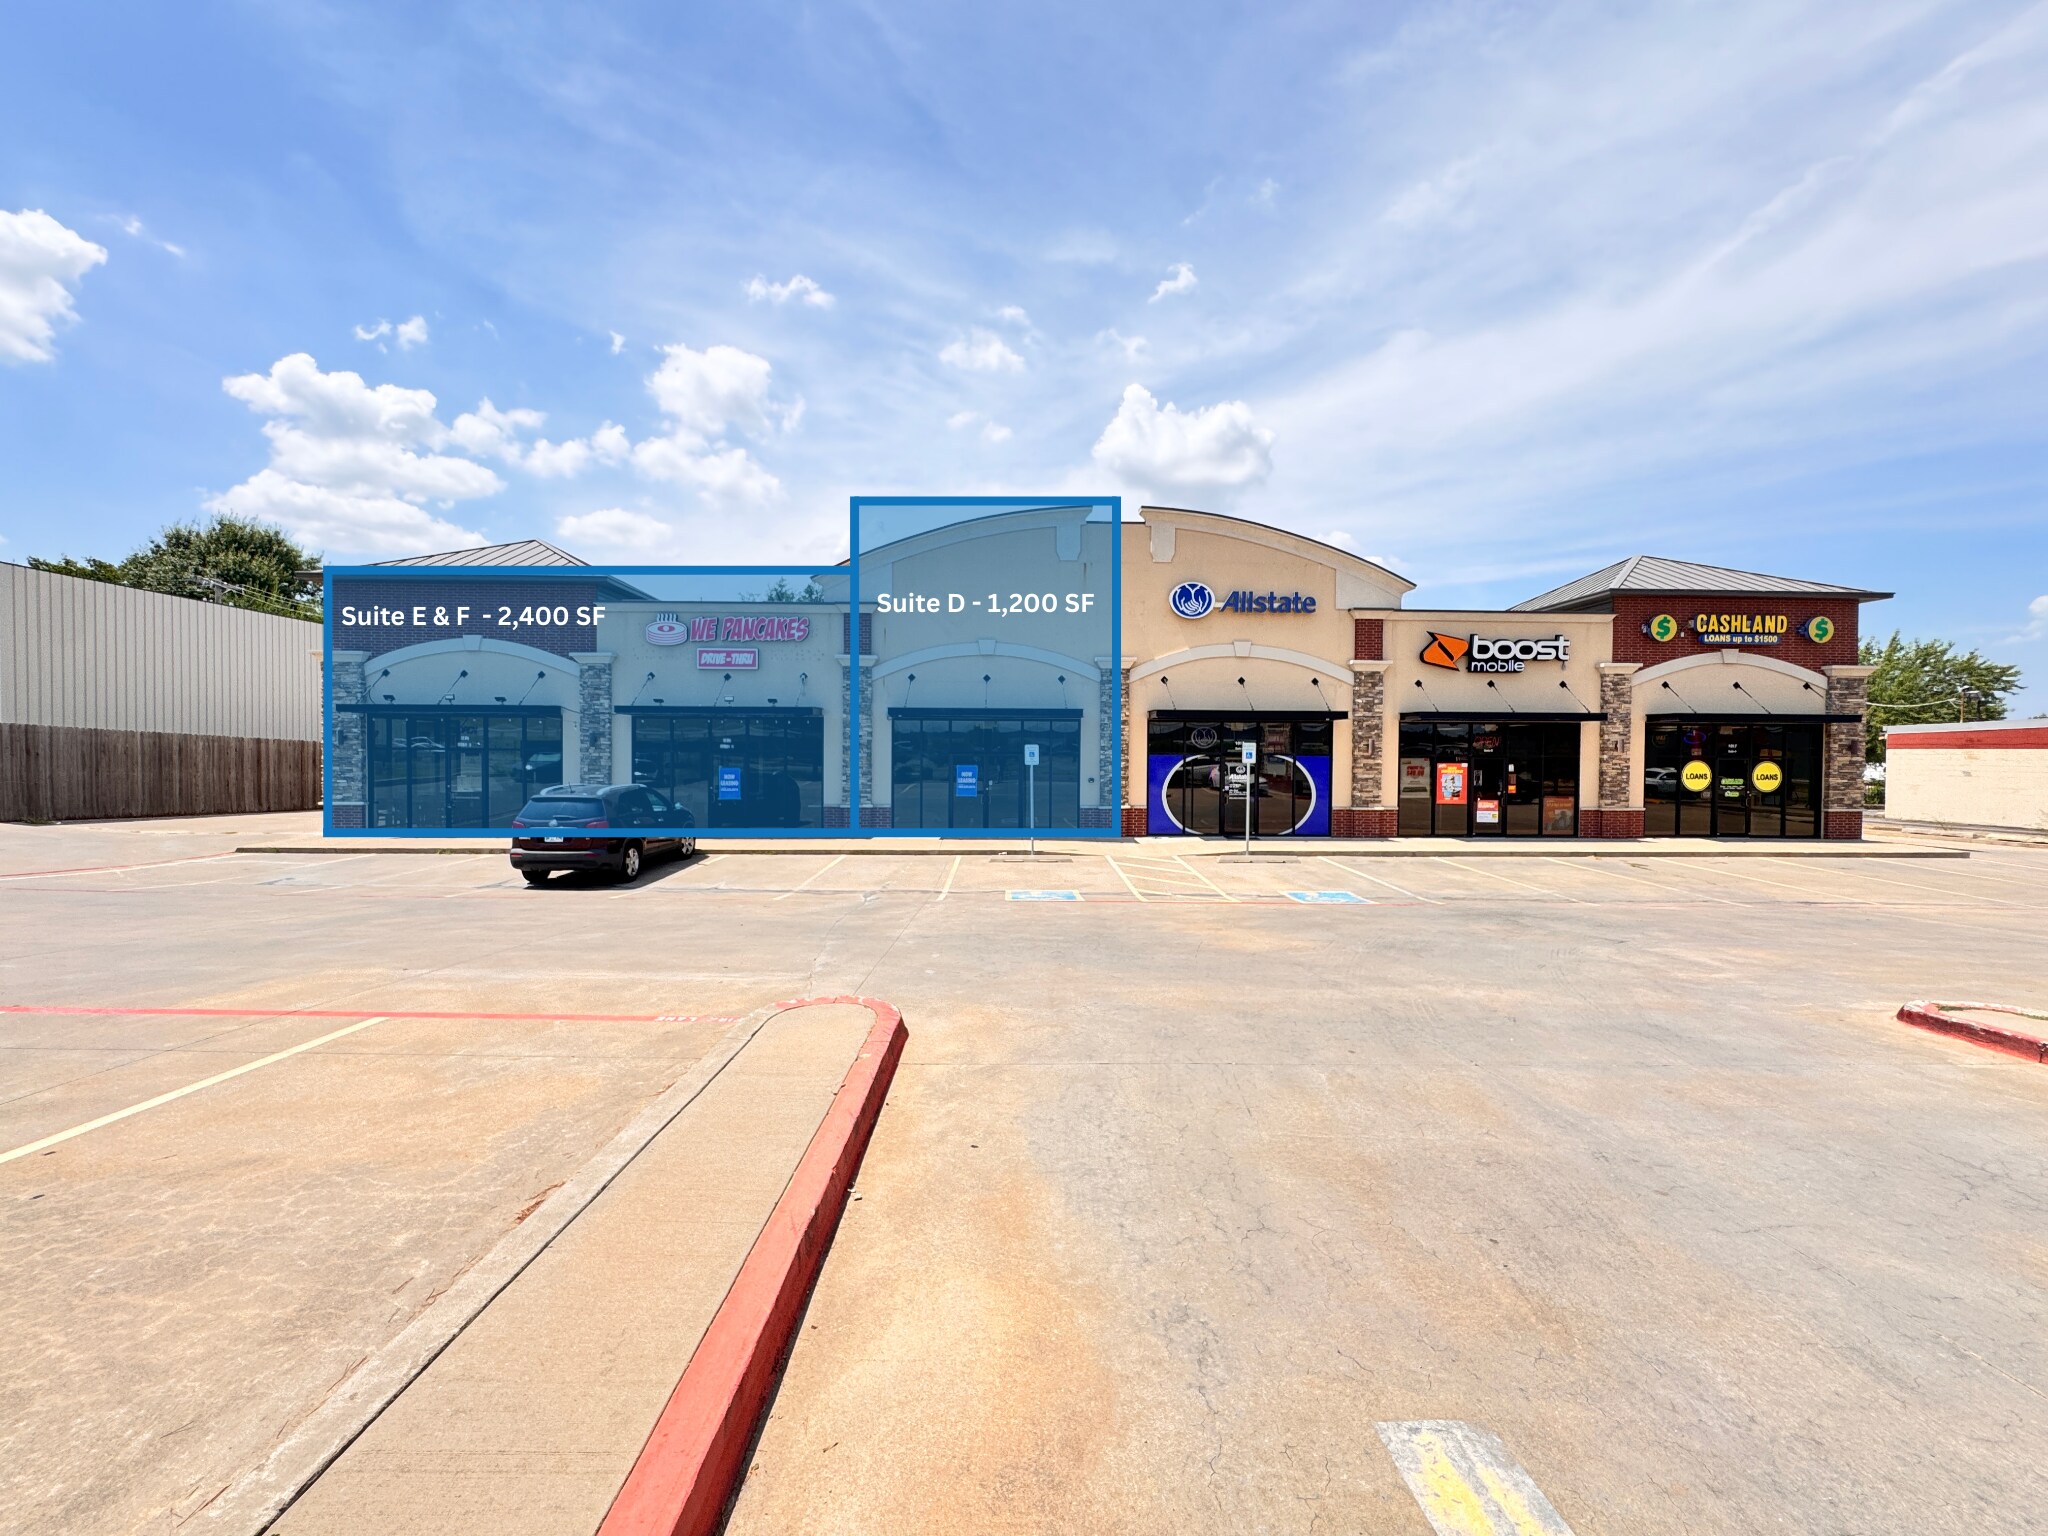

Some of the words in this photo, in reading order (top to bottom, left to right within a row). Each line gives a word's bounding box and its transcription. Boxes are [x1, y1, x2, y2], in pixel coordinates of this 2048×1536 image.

[1219, 590, 1317, 613] Allstate
[690, 616, 718, 642] WE
[721, 616, 810, 642] PANCAKES
[1696, 613, 1788, 634] CASHLAND
[1471, 634, 1570, 660] boost
[1733, 636, 1742, 644] up
[1744, 635, 1752, 643] to
[1754, 635, 1778, 643] $1500
[1471, 660, 1525, 672] mobile
